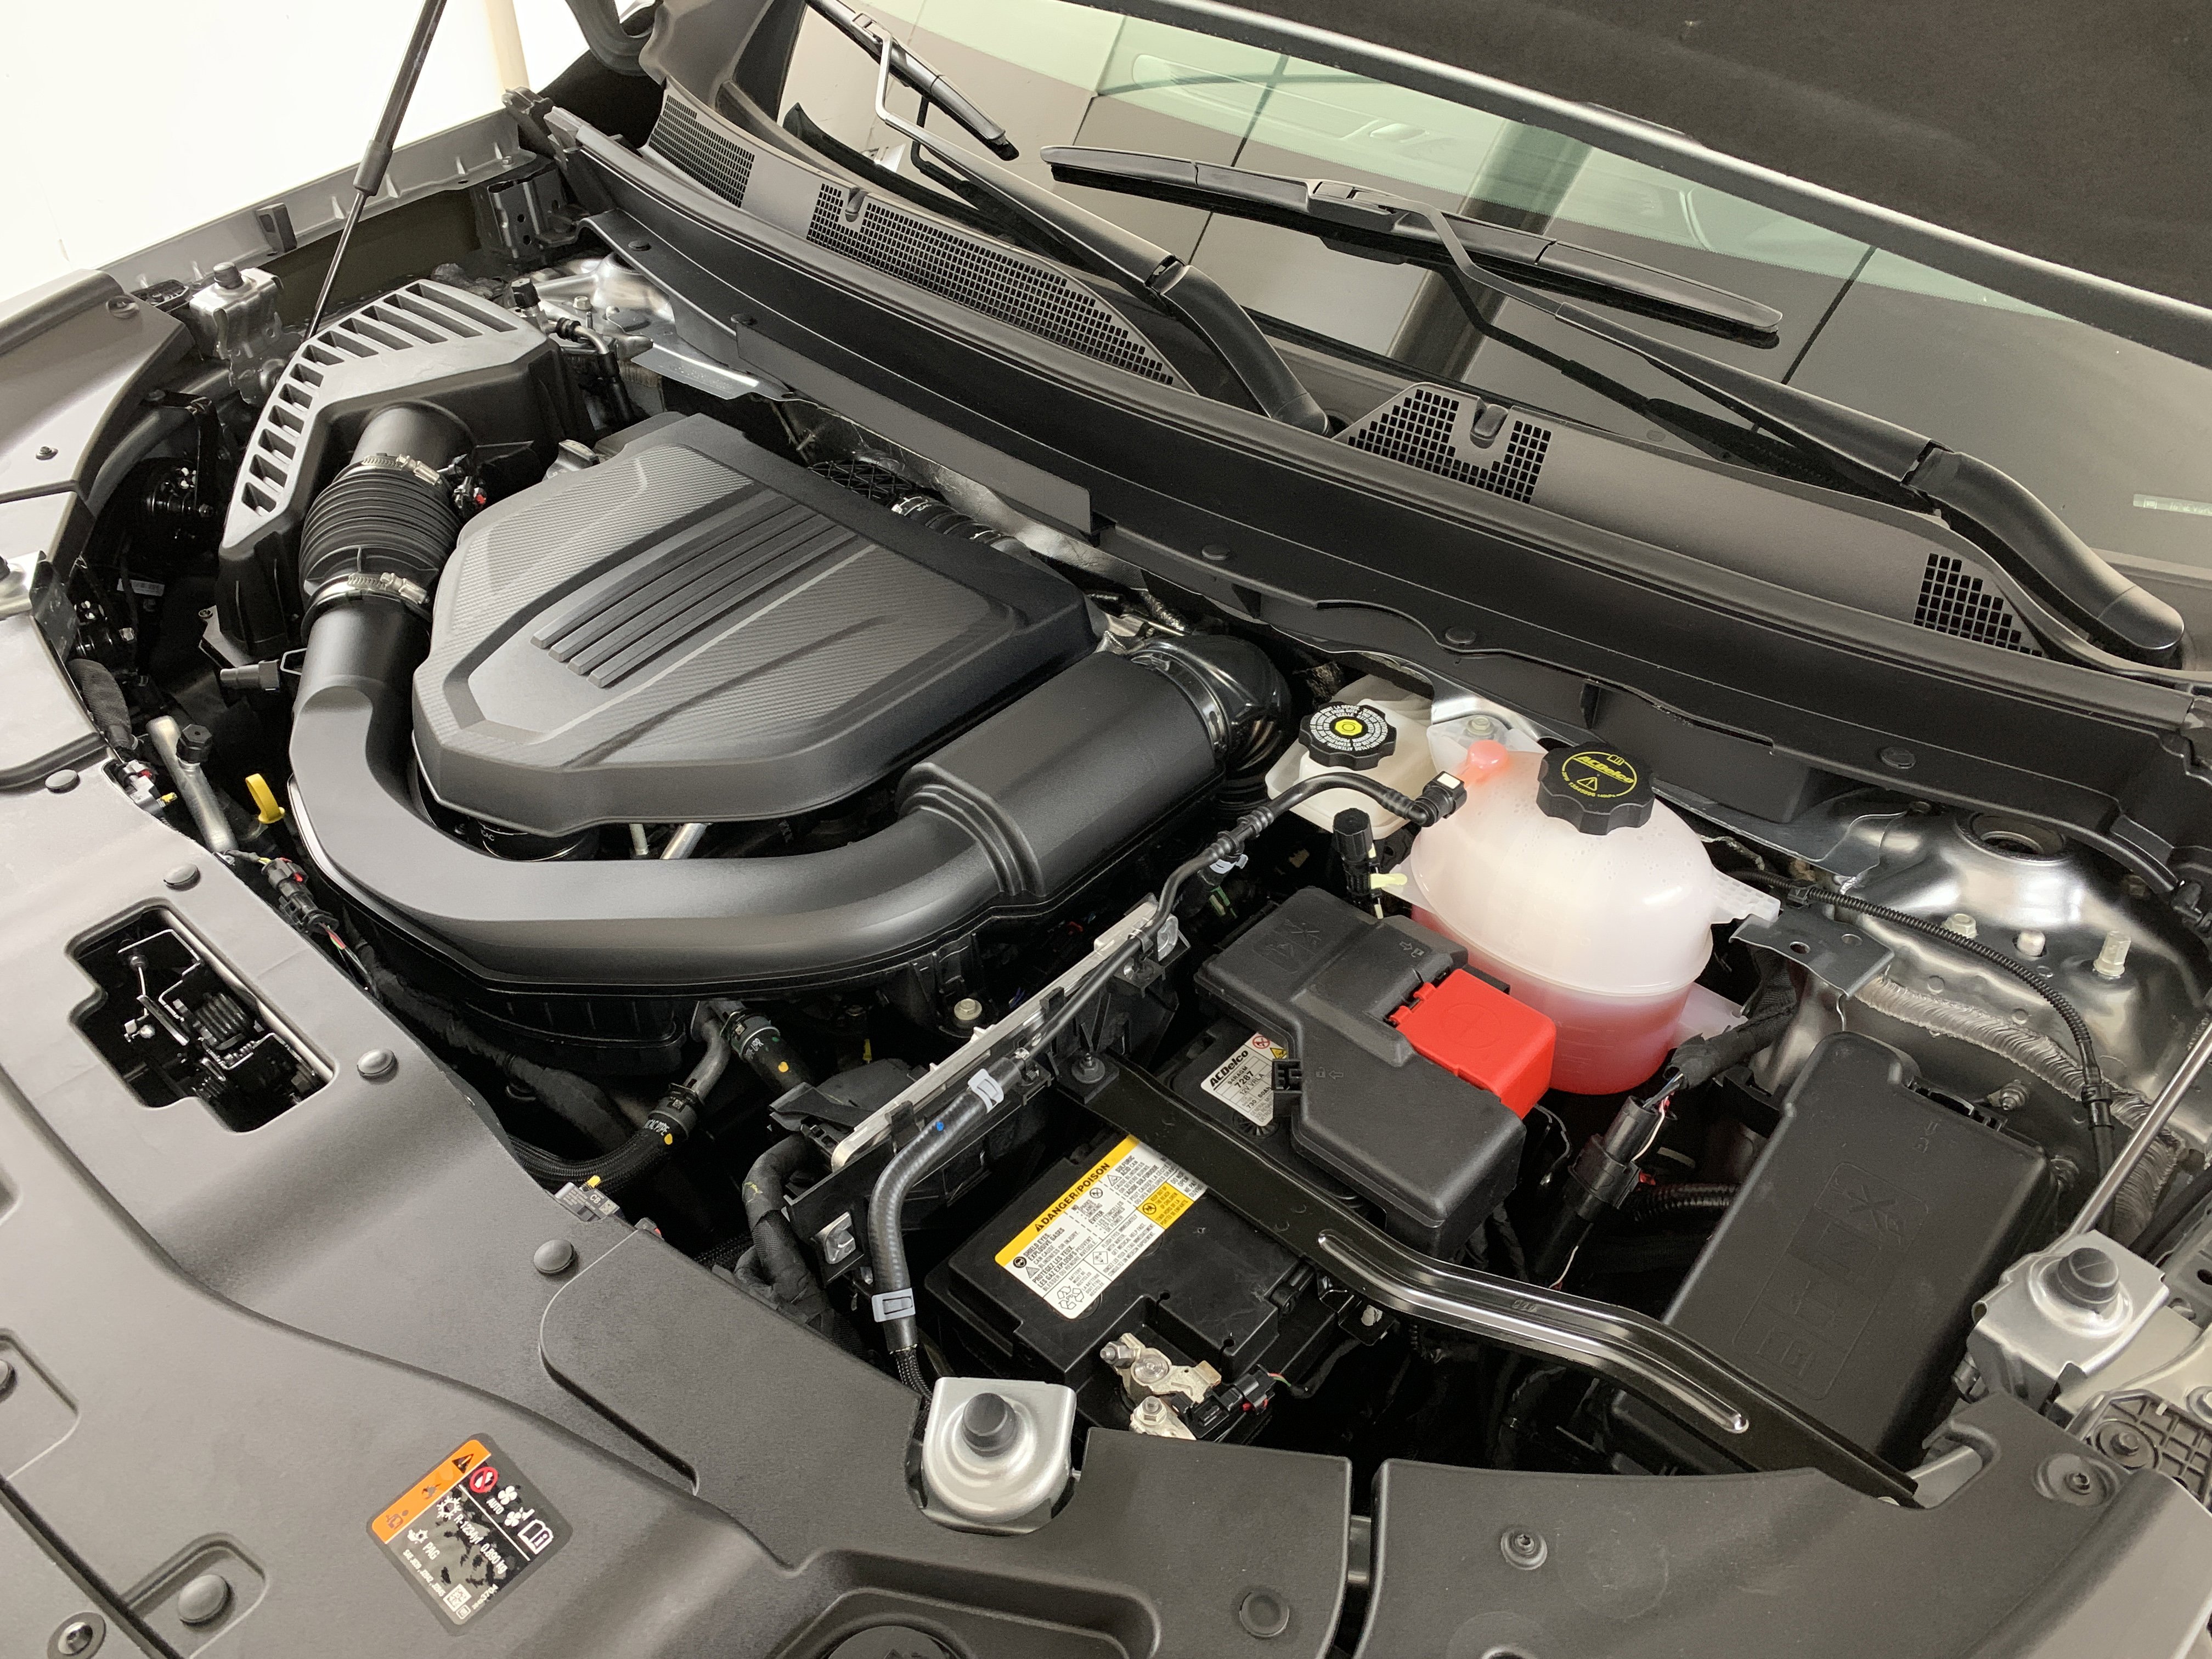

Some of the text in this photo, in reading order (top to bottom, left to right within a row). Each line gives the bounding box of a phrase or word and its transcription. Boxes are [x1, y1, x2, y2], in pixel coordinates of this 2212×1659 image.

[1578, 756, 1634, 784] ACDelco
[750, 1037, 764, 1052] UPR
[1210, 1050, 1248, 1086] ACDelco
[1227, 1065, 1248, 1084] 94RAGM
[1234, 1070, 1253, 1087] 7287
[1239, 1073, 1264, 1094] 12V VRLA
[1246, 1099, 1256, 1108] 730
[653, 1121, 670, 1136] PIPE
[1115, 1155, 1135, 1172] SULFURIC
[1120, 1166, 1131, 1176] ACID
[1114, 1162, 1144, 1189] CAUSE BLINDNESS
[1123, 1165, 1159, 1197] L'ACIDE SULFURIQUE
[1124, 1176, 1138, 1188] SEVERE
[590, 1194, 601, 1204] CB
[1041, 1163, 1109, 1224] DANGER/POISON
[1129, 1191, 1139, 1201] PEUT
[1138, 1179, 1153, 1193] CAUSER
[1088, 1210, 1104, 1224] ÉVITER
[1102, 1200, 1124, 1220] ÉTINCELLES
[1107, 1206, 1125, 1222] FLAMMES
[1110, 1215, 1123, 1227] FUMER
[1023, 1233, 1049, 1257] SHIELD EYES.
[1028, 1227, 1064, 1261] EXPLOSIVE GASES
[1038, 1249, 1059, 1268] BLINDNESS
[1064, 1231, 1078, 1244] INJURY.
[1032, 1245, 1074, 1283] PROTÉGEZ LES YEUX.
[1033, 1245, 1054, 1265] CAN CAUSE
[1037, 1235, 1092, 1288] LES GAZ EXPLOSIFS PEUVENT
[1042, 1274, 1060, 1291] BLESSER
[1064, 1256, 1080, 1270] RENDRE
[1079, 1240, 1096, 1257] AVEUGLE.
[486, 1498, 504, 1514] AUTO
[422, 1542, 439, 1559] PAG
[453, 1514, 507, 1574] R-1234yf 0.890 kg
[403, 1549, 413, 1560] SAE
